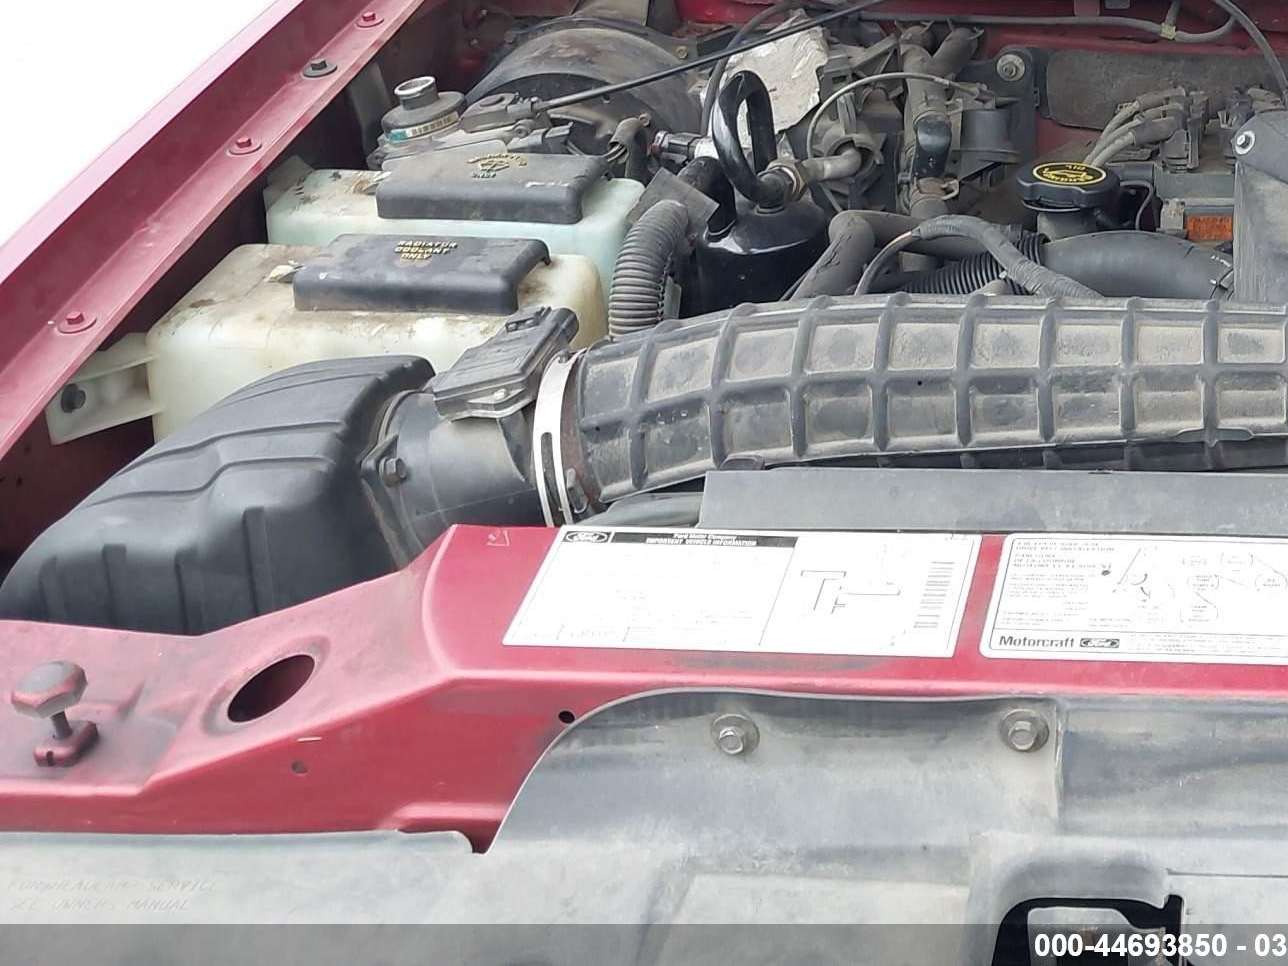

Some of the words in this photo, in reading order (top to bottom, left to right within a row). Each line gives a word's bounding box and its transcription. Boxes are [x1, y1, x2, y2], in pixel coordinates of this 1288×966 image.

[397, 240, 458, 248] RADIATOR
[712, 539, 758, 547] INFORMATION
[998, 635, 1075, 648] Motorcraft
[127, 897, 190, 911] MANUAL
